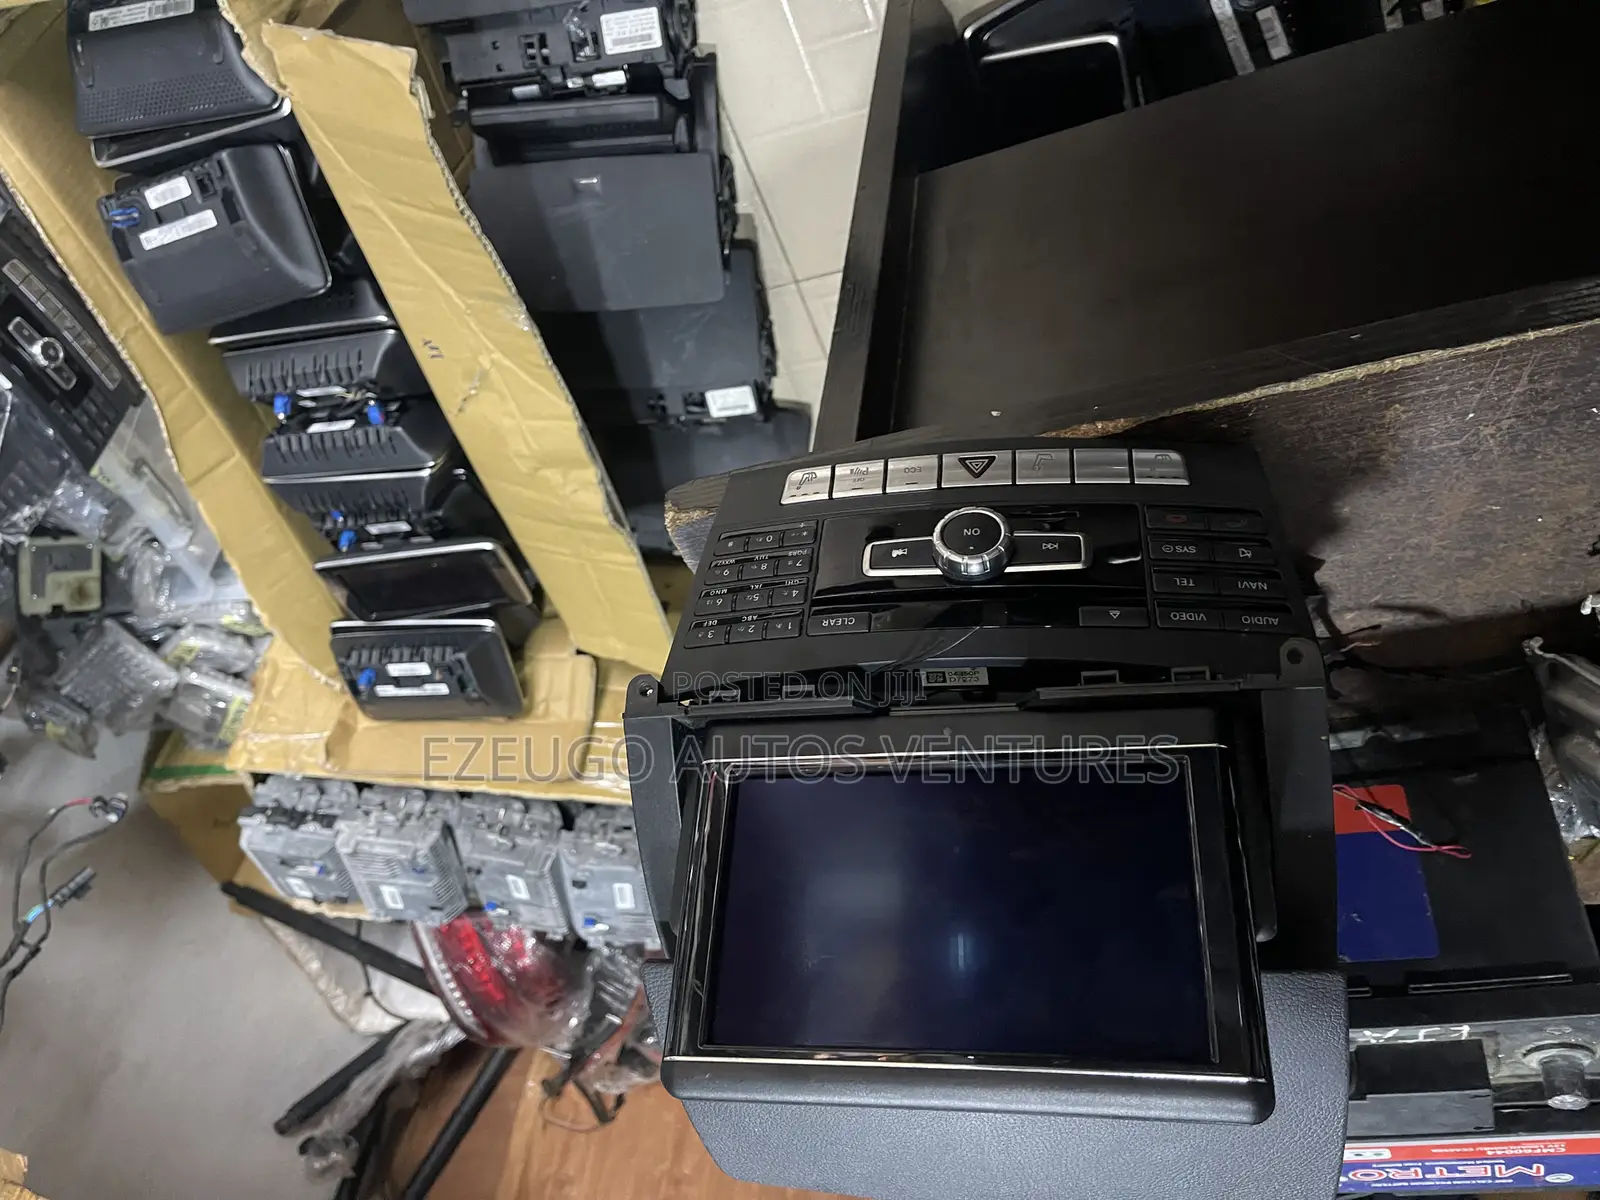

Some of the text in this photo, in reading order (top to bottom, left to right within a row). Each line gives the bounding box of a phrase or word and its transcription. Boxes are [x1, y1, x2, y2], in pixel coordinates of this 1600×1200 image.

[963, 528, 981, 536] ON
[1175, 545, 1196, 553] SYS
[1174, 577, 1195, 586] TEL
[1237, 580, 1268, 590] NAVI
[709, 588, 728, 596] MNO
[752, 593, 760, 601] 5
[716, 598, 723, 606] 6
[741, 614, 758, 622] ABC
[1170, 611, 1207, 621] VIDEO
[1241, 615, 1279, 625] AUDIO
[822, 617, 856, 627] CLEAR
[748, 624, 755, 633] 2
[707, 630, 715, 638] 3
[1348, 1163, 1545, 1182] METRO
